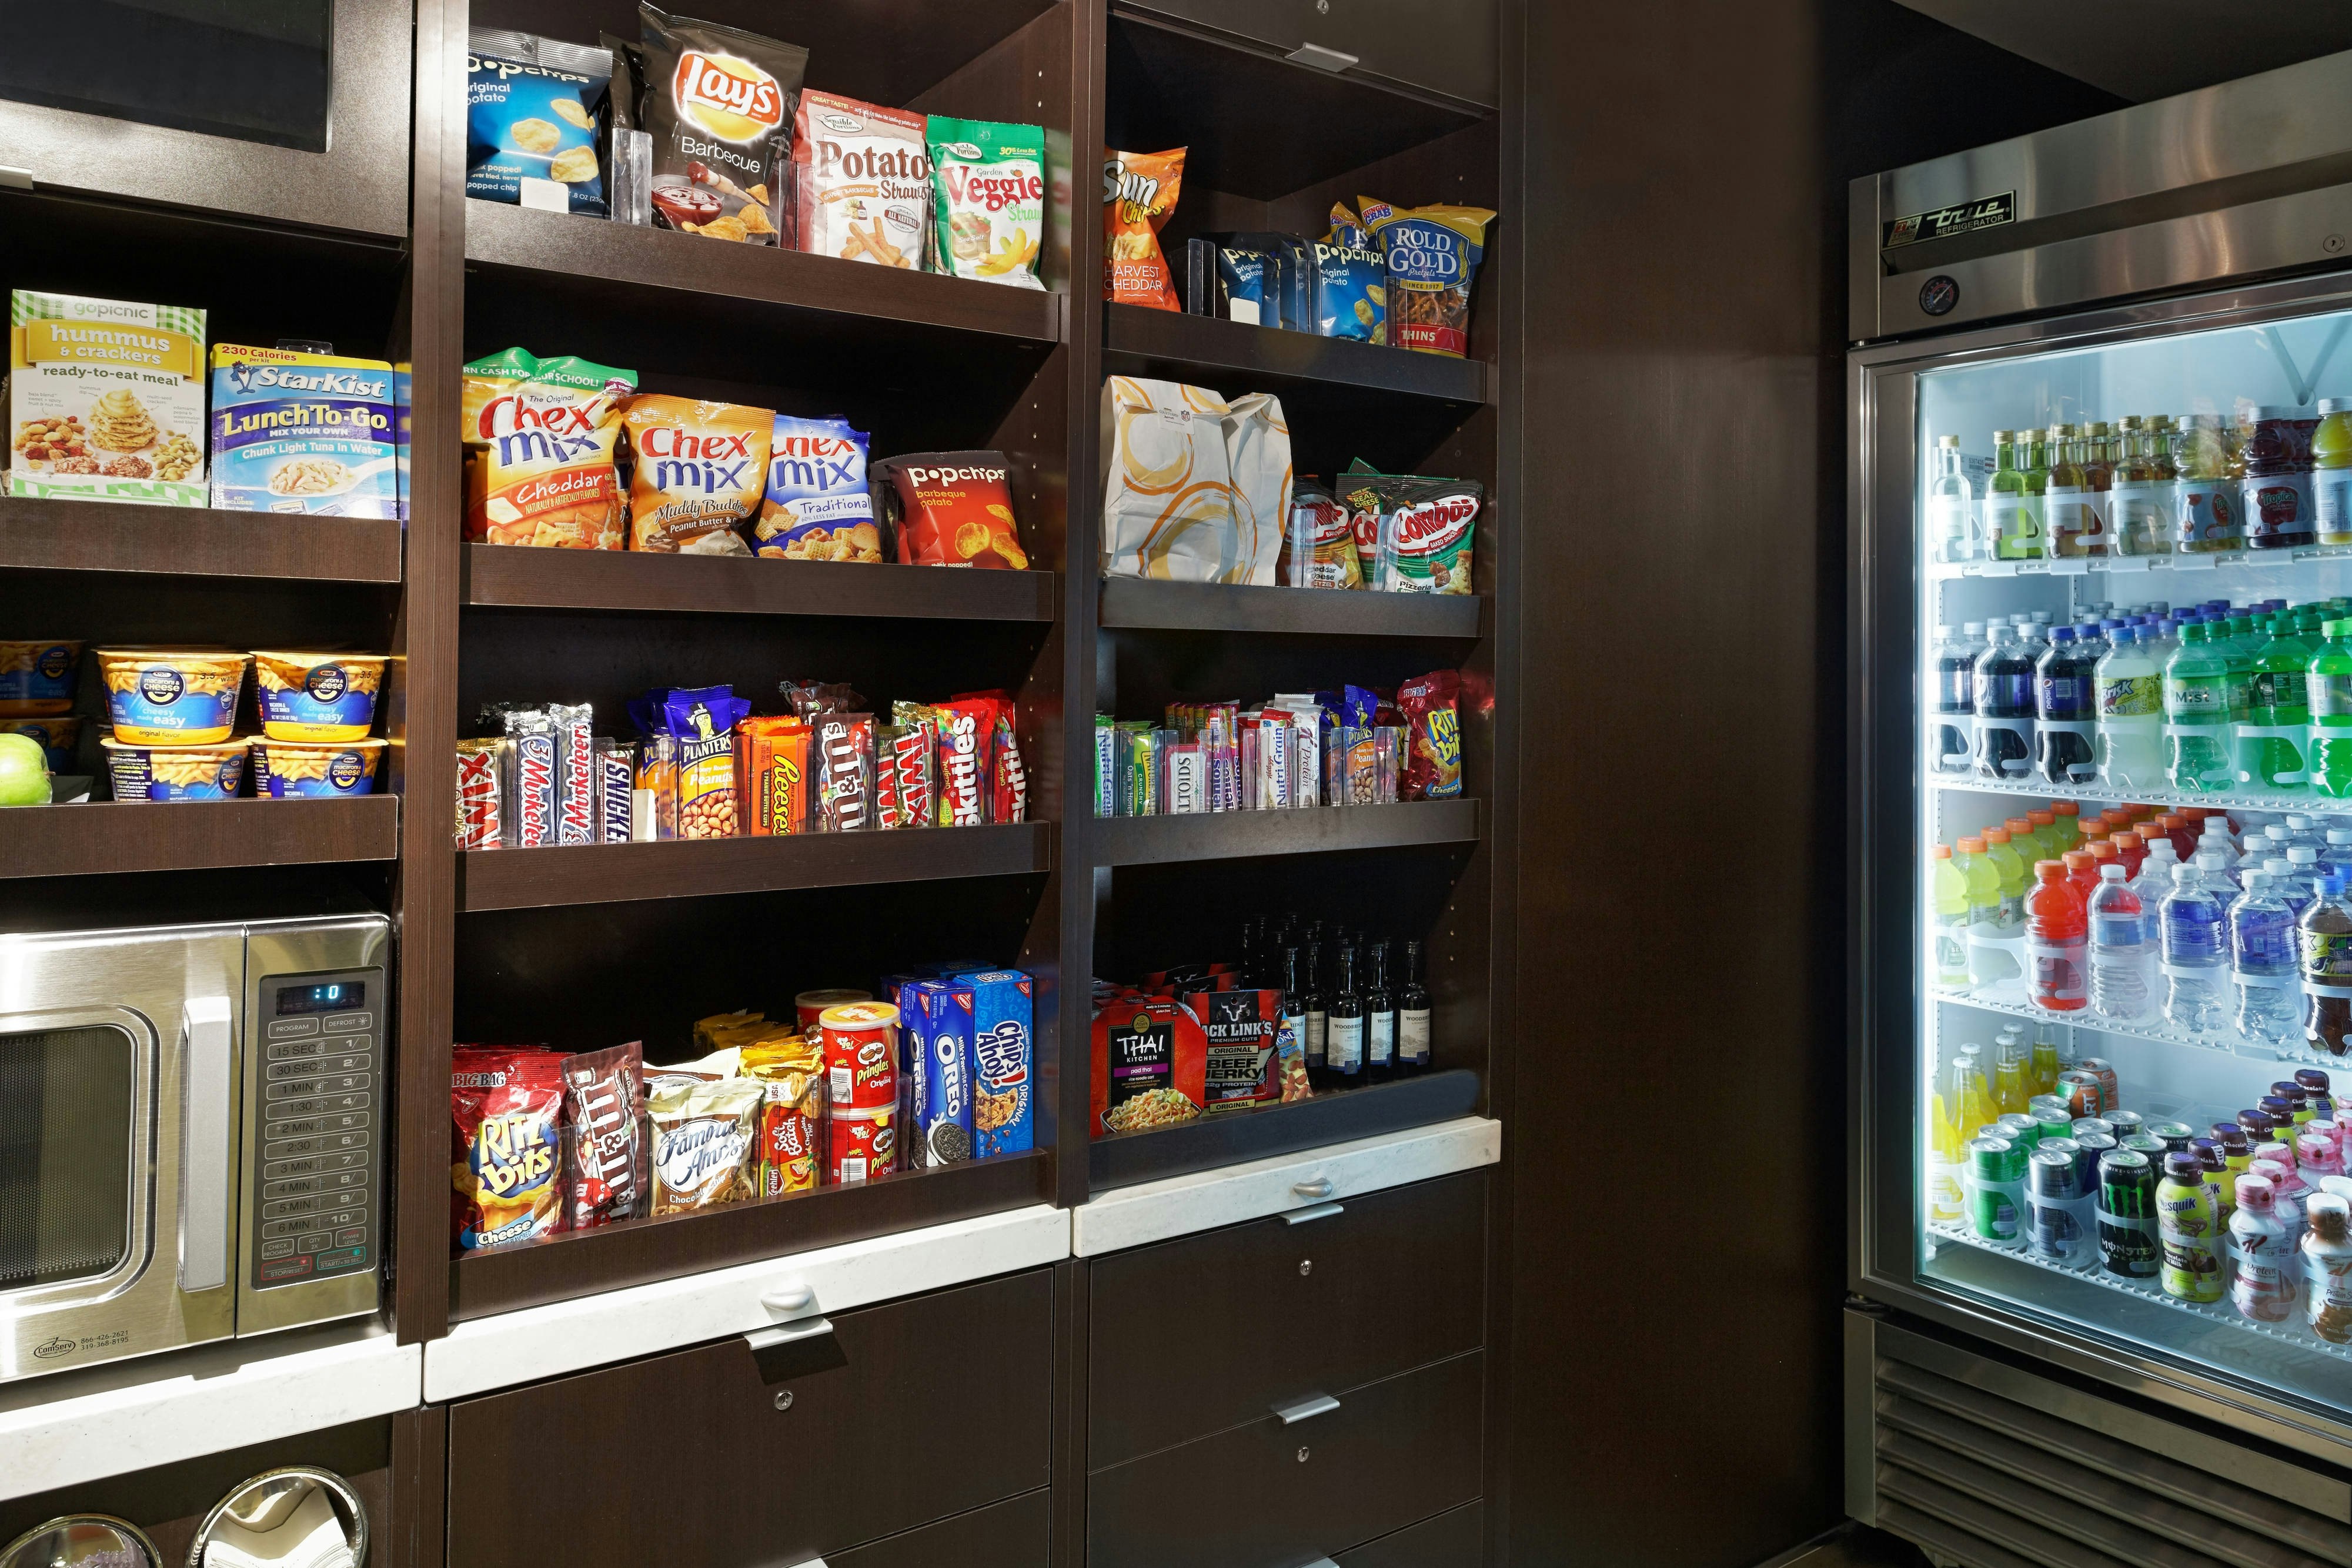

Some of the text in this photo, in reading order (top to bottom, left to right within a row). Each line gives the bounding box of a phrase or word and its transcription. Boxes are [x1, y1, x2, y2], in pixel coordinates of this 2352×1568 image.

[685, 54, 775, 116] Lay's
[681, 136, 761, 173] Barbecue
[816, 141, 929, 180] Potato
[977, 168, 1003, 176] Garden
[467, 182, 517, 193] popped chip
[881, 180, 927, 200] Straws
[939, 165, 1043, 212] Veggie
[1104, 160, 1159, 206] Sun
[887, 211, 918, 226] ALL NATURAL
[1365, 208, 1392, 225] GRAB
[1926, 201, 2004, 228] true
[1936, 215, 2004, 235] REFRIGERATOR
[1396, 228, 1451, 252] ROLD
[1389, 248, 1456, 275] GOLD
[1105, 266, 1159, 278] HARVEST
[1104, 279, 1164, 290] CHEDDAR
[50, 325, 170, 352] hummus
[1401, 330, 1435, 341] THINS
[60, 345, 161, 365] & crackers
[222, 346, 297, 362] 230 Calories
[44, 366, 178, 386] ready-to-eat meal
[258, 366, 386, 398] StarKist
[555, 373, 599, 387] SCHOOL!
[546, 394, 574, 402] Original
[218, 403, 309, 436] Lunch
[479, 394, 602, 439] Chex
[270, 429, 289, 437] MIX
[242, 442, 382, 459] Chunk Light Tuna In Water
[499, 432, 601, 467] mix
[641, 427, 752, 460] Chex
[657, 460, 750, 493] mix
[776, 454, 856, 491] mix
[907, 467, 1005, 487] popchips
[517, 472, 602, 504] Cheddar
[916, 490, 966, 500] barbeque
[526, 497, 550, 514] NATURALLY
[555, 492, 580, 506] ARTIFICIALLY
[580, 488, 600, 500] FLAVORED
[800, 497, 870, 514] Traditional
[920, 497, 953, 510] potato
[1352, 493, 1375, 503] REAL
[1354, 497, 1379, 509] CHEESE
[654, 499, 748, 524] Muddy Buddies
[670, 523, 696, 533] Peanut
[699, 517, 723, 527] Butter
[1393, 499, 1475, 543] Combos
[2176, 689, 2210, 703] Mist
[142, 708, 175, 716] cheesy
[308, 704, 337, 713] cheesy
[153, 716, 186, 728] easy
[318, 714, 343, 724] easy
[1428, 710, 1458, 740] RITZ
[684, 735, 731, 763] PLANTERS
[564, 724, 589, 828] Musketeers
[1432, 784, 1458, 794] Cheese
[1231, 1021, 1272, 1037] LINK'S
[277, 1045, 316, 1056] 15 SEC
[995, 1023, 1024, 1071] Chips
[1117, 1035, 1163, 1057] THAI
[277, 1062, 317, 1075] 30 SEC
[1207, 1058, 1258, 1069] BEEF
[453, 1072, 505, 1086] BIG BAG
[857, 1059, 888, 1086] Pringles
[937, 1034, 959, 1117] OREO
[292, 1083, 313, 1092] MIN
[870, 1076, 891, 1088] Original
[290, 1102, 312, 1112] 1:30
[1010, 1085, 1028, 1126] ORIGINAL
[1216, 1102, 1249, 1110] ORIGINAL
[282, 1122, 313, 1133] 2 MIN
[800, 1116, 809, 1146] Chocolate
[479, 1114, 544, 1164] RITZ
[656, 1119, 736, 1166] Famous
[772, 1124, 789, 1151] Soft
[783, 1116, 802, 1156] Batch
[288, 1141, 310, 1152] 2:30
[281, 1161, 312, 1173] 3 MIN
[479, 1146, 551, 1194] bits
[279, 1182, 310, 1192] 4 MIN
[279, 1201, 310, 1212] 5 MIN
[2160, 1198, 2196, 1213] Nesquik
[279, 1221, 309, 1232] 6 MIN
[477, 1221, 532, 1245] Cheese
[263, 1249, 292, 1257] PROGRAM
[270, 1268, 303, 1277] STOP/RESET
[2247, 1263, 2276, 1275] Protein
[2326, 1289, 2346, 1298] Protein
[81, 1330, 128, 1343] 866-426-2621
[81, 1337, 129, 1350] 319-368-8195
[38, 1342, 72, 1353] ComServ
